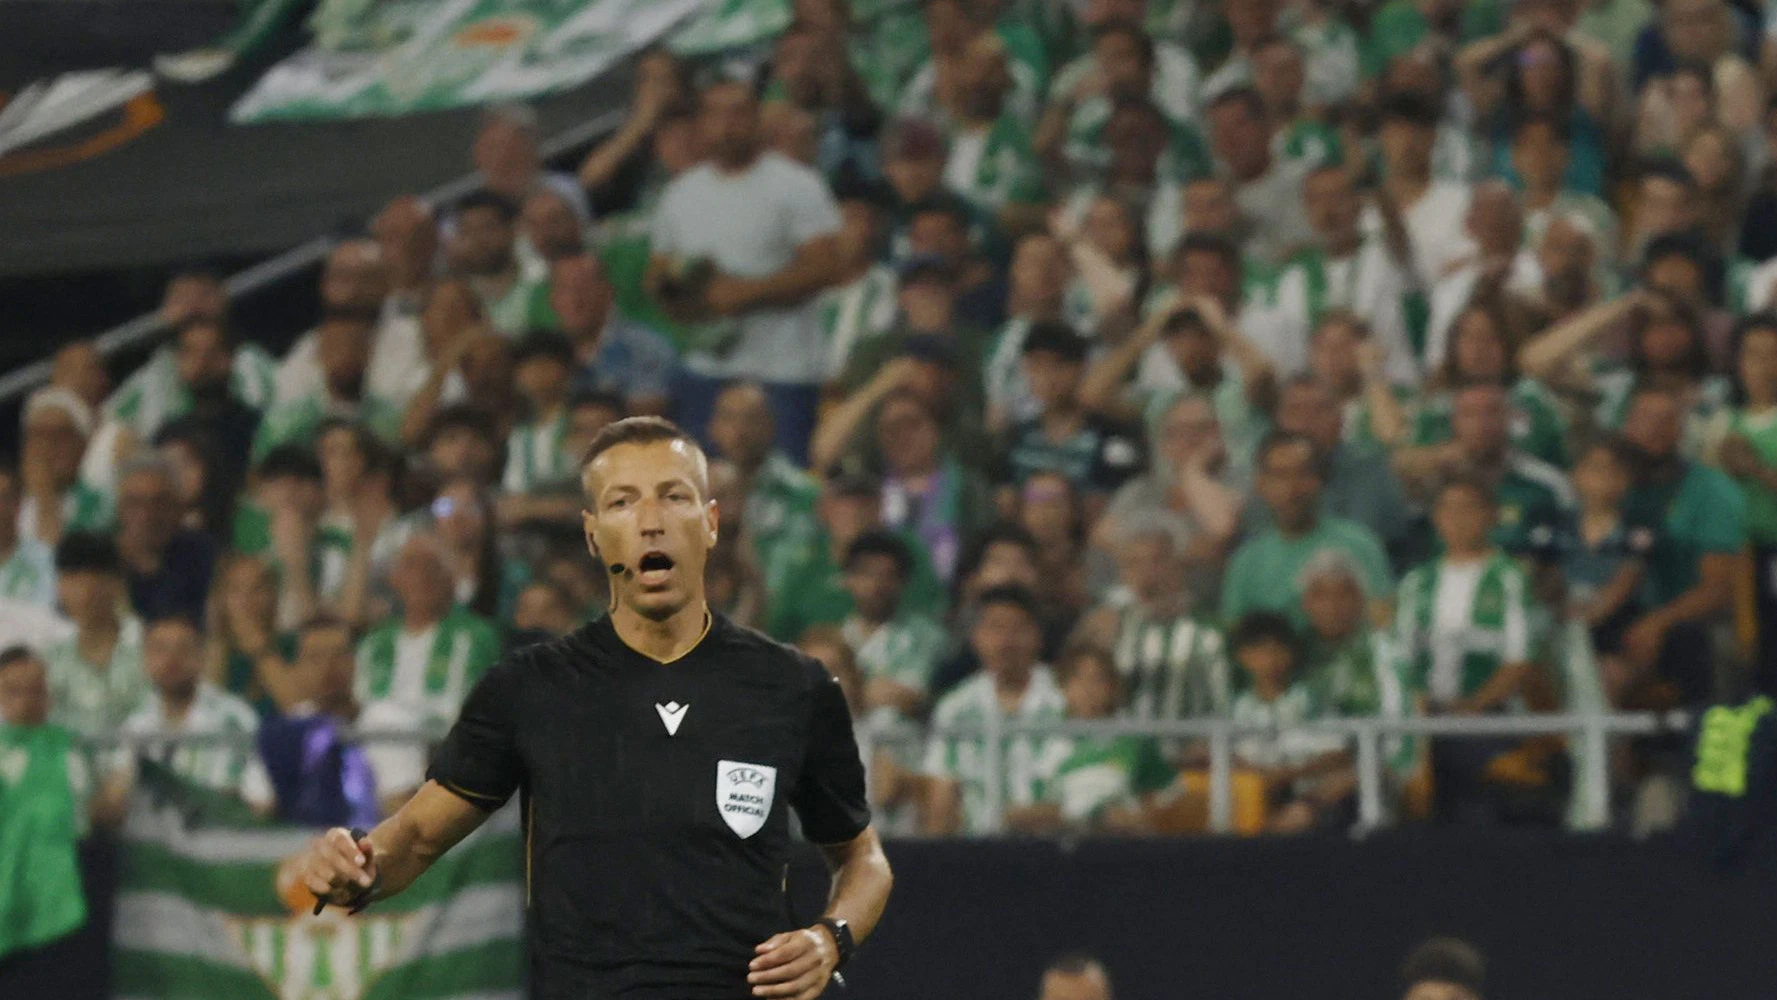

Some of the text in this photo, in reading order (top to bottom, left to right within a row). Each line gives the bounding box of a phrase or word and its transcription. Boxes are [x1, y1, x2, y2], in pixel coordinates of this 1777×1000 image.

[729, 768, 765, 788] UEFA
[729, 793, 764, 804] MATCH
[724, 804, 765, 817] OFFICIAL
